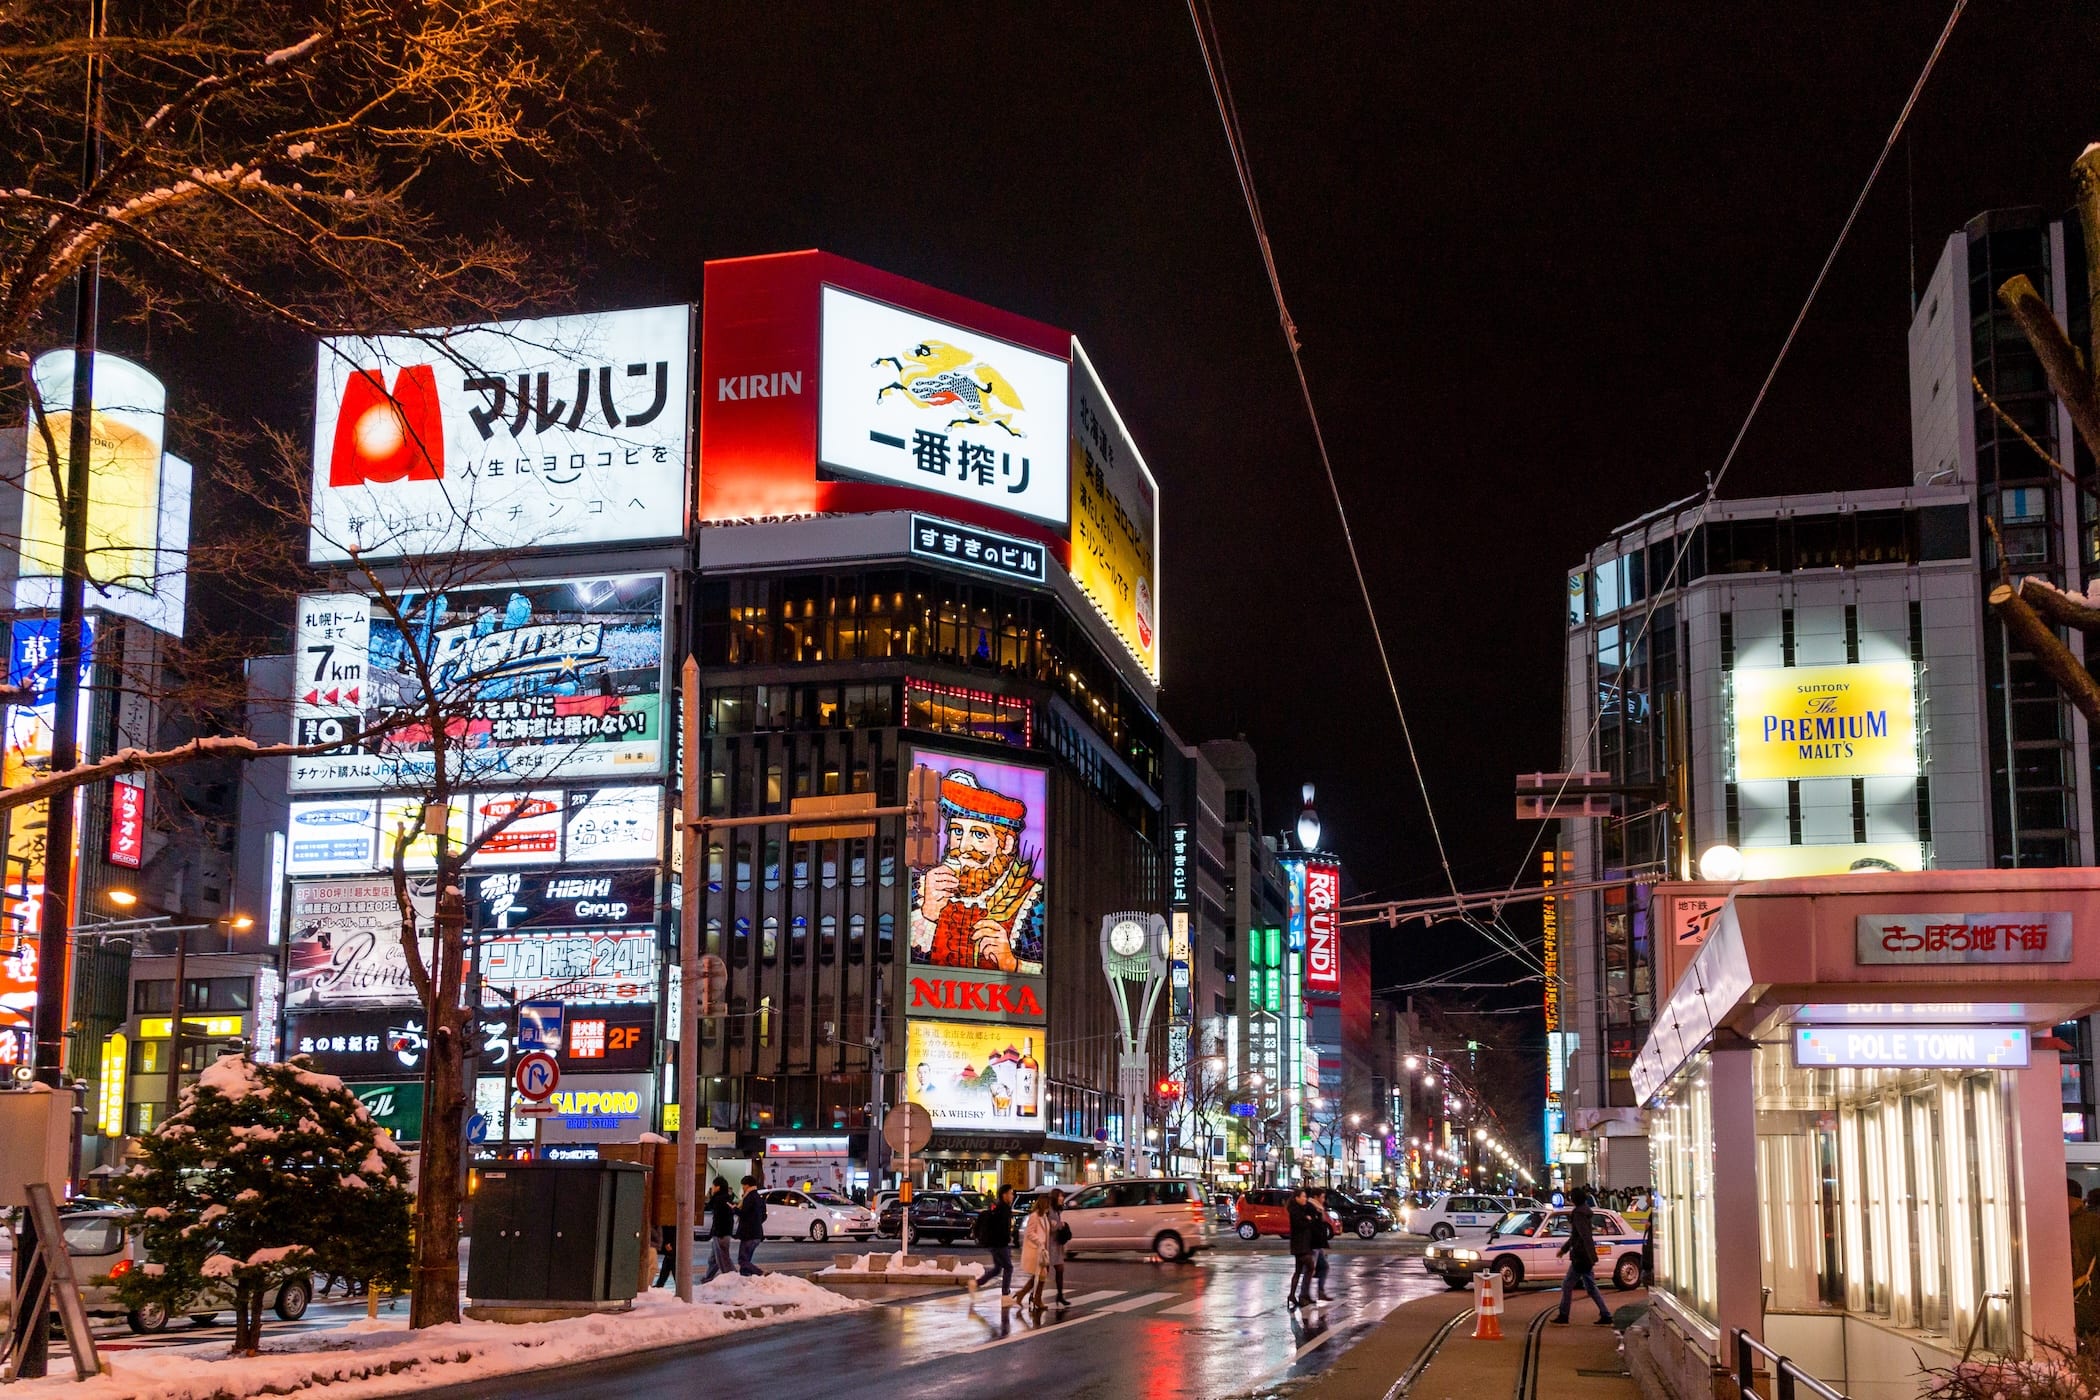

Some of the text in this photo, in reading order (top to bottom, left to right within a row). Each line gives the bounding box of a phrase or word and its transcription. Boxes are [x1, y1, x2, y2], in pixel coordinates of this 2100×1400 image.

[463, 360, 668, 441] マルハン
[718, 371, 802, 401] KIRIN
[460, 446, 668, 479] 人生にヨロコビを
[870, 427, 1030, 494] 一番搾り
[918, 527, 1037, 572] すすきのビル
[305, 611, 366, 628] 札幌ドーム
[307, 645, 361, 682] 7km
[1797, 683, 1850, 694] SUNTORY
[1804, 695, 1839, 715] The
[1763, 710, 1888, 743] PREMIUM
[1798, 740, 1854, 761] MALT'S
[117, 786, 138, 852] カラオケ
[1173, 828, 1187, 900] すすきのビル
[575, 900, 628, 920] Group
[1678, 900, 1708, 911] 地下鉄
[1882, 924, 2048, 953] さっぽろ地下街
[594, 938, 651, 978] 24H
[910, 976, 1043, 1017] NIKKA
[299, 1035, 380, 1053] 北の味紀行
[608, 1027, 641, 1049] 2F
[1848, 1033, 1975, 1060] POLE TOWN
[1264, 1022, 1277, 1110] 第23桂和ビル
[550, 1091, 639, 1114] SAPPORO
[948, 1110, 986, 1119] WHISKY
[566, 1118, 620, 1129] DRUG STORE
